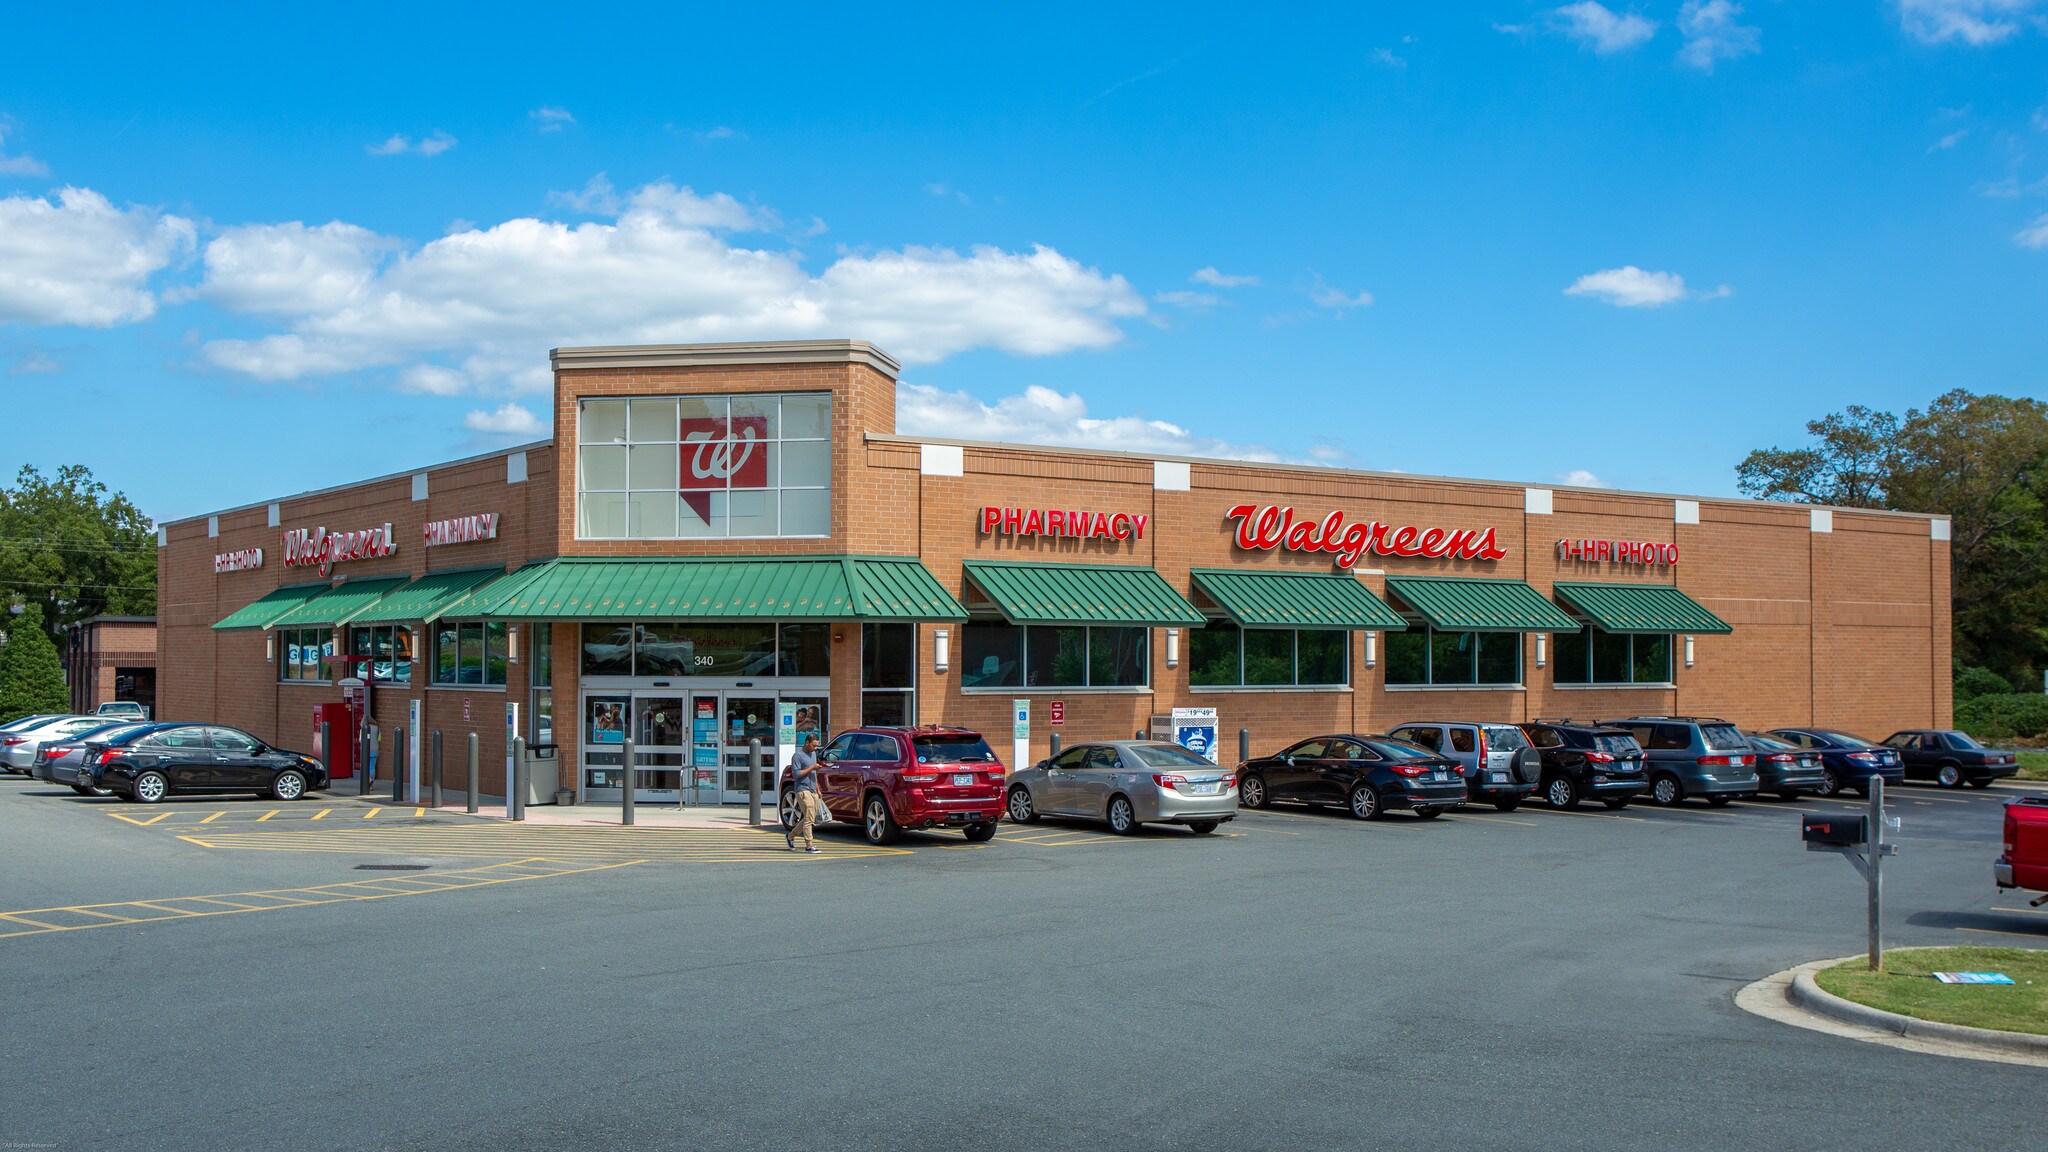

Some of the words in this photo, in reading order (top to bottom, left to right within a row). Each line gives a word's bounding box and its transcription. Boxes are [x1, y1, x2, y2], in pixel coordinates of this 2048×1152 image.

[686, 426, 756, 480] W
[423, 512, 499, 547] PHARMACY
[982, 506, 1150, 541] PHARMACY
[1227, 503, 1508, 569] Walgreens
[283, 522, 397, 578] Walgreens
[1560, 539, 1610, 562] 1-HR
[1614, 541, 1680, 566] PHOTO
[694, 655, 714, 666] 340
